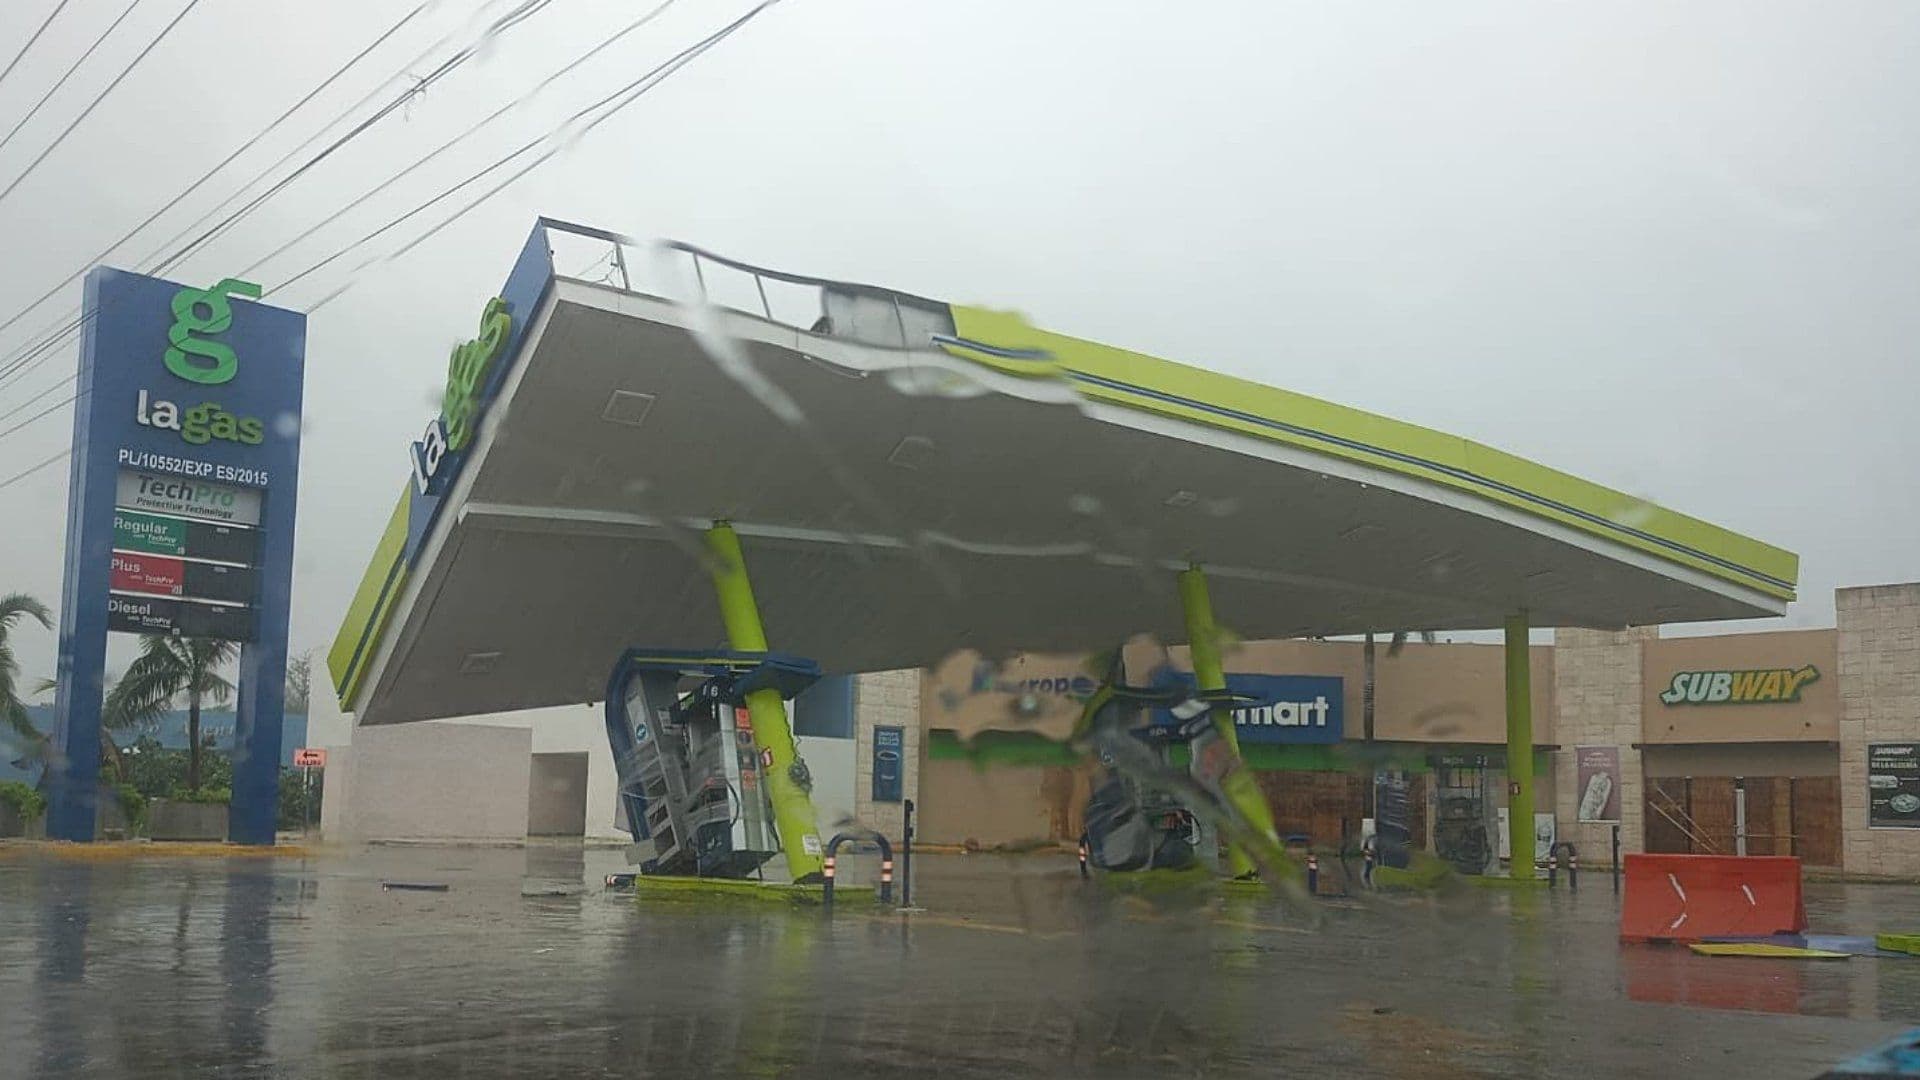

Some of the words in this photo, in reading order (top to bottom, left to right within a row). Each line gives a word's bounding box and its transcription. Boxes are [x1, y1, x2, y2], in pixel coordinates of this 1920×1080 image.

[137, 389, 264, 445] lagas
[118, 448, 213, 477] PL/10552/EXP
[216, 465, 269, 486] ES/2015
[137, 474, 235, 507] TechPro
[136, 496, 184, 511] Protective
[185, 503, 235, 519] Technology
[113, 516, 169, 535] Regular
[111, 558, 141, 573] Plus
[108, 599, 151, 616] Diesel
[1661, 665, 1819, 705] SUBWAY
